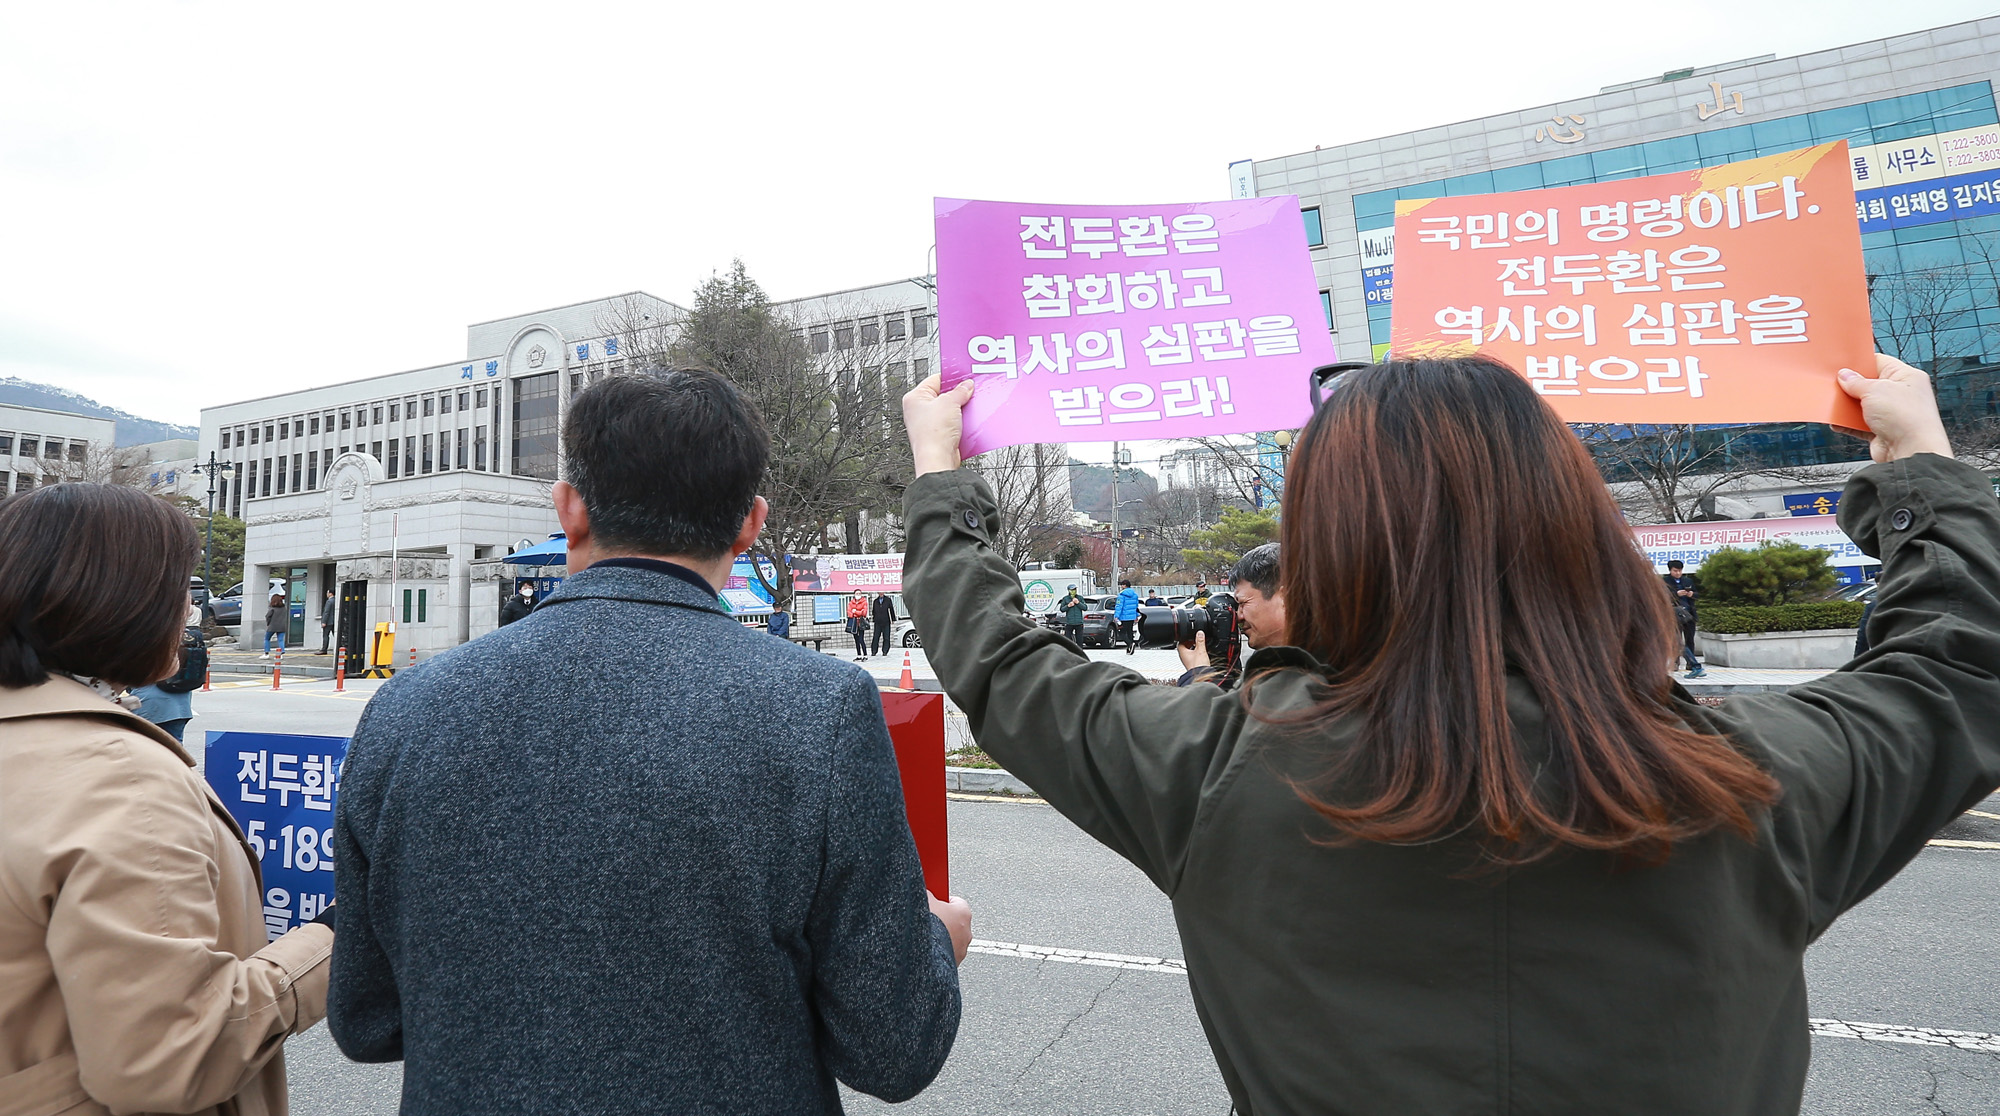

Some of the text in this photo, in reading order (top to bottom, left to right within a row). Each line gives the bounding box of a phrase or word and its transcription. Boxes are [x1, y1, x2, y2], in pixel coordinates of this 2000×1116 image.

[1886, 147, 1936, 174] 사무소
[1943, 132, 1999, 152] T.222-3800
[1947, 148, 2000, 167] F.222-3803
[1417, 175, 1821, 251] 국민의 명령이다.
[1891, 188, 1949, 218] 임채영
[1019, 213, 1220, 259] 전두환은
[1495, 245, 1726, 297] 전두환은
[1021, 267, 1232, 319] 참회하고
[1434, 294, 1809, 347] 역사의 심판을
[461, 338, 618, 380] 지방 법원
[967, 315, 1301, 379] 역사의 심판을
[1526, 354, 1709, 399] 받으라
[1049, 376, 1236, 426] 받으라!
[1813, 497, 1838, 515] 송
[1641, 532, 1696, 547] 10년만의
[1700, 528, 1766, 544] 단체교섭!!
[1814, 542, 1864, 558] 구한
[845, 558, 875, 569] 법원본부
[847, 572, 881, 586] 양승태와
[236, 750, 343, 811] 전두환
